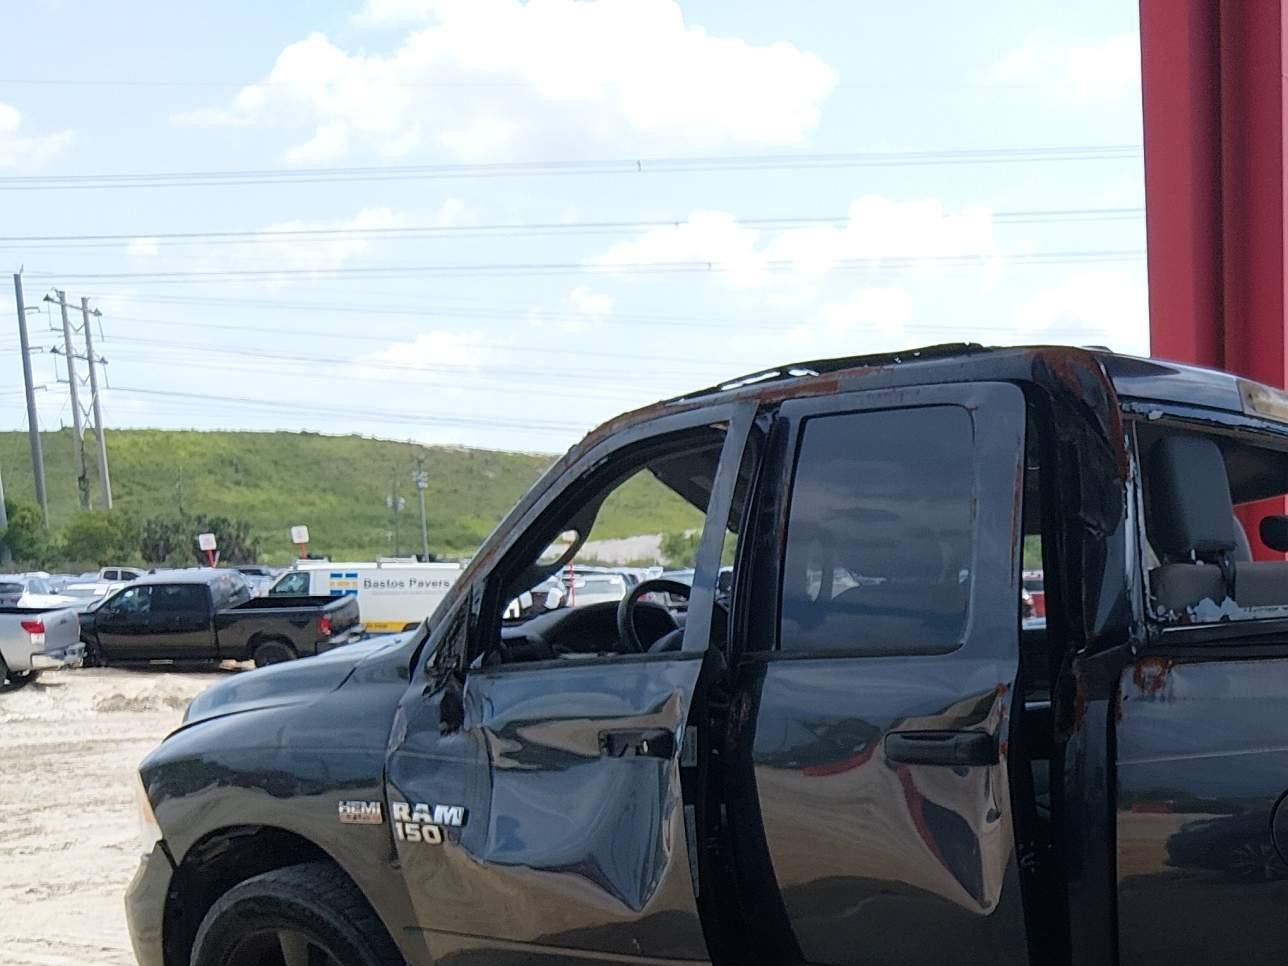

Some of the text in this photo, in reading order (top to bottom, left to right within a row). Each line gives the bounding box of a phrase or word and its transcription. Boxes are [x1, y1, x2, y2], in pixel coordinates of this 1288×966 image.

[363, 577, 450, 589] Bastos Pavers
[339, 800, 381, 815] HEMI
[393, 802, 464, 825] RAM
